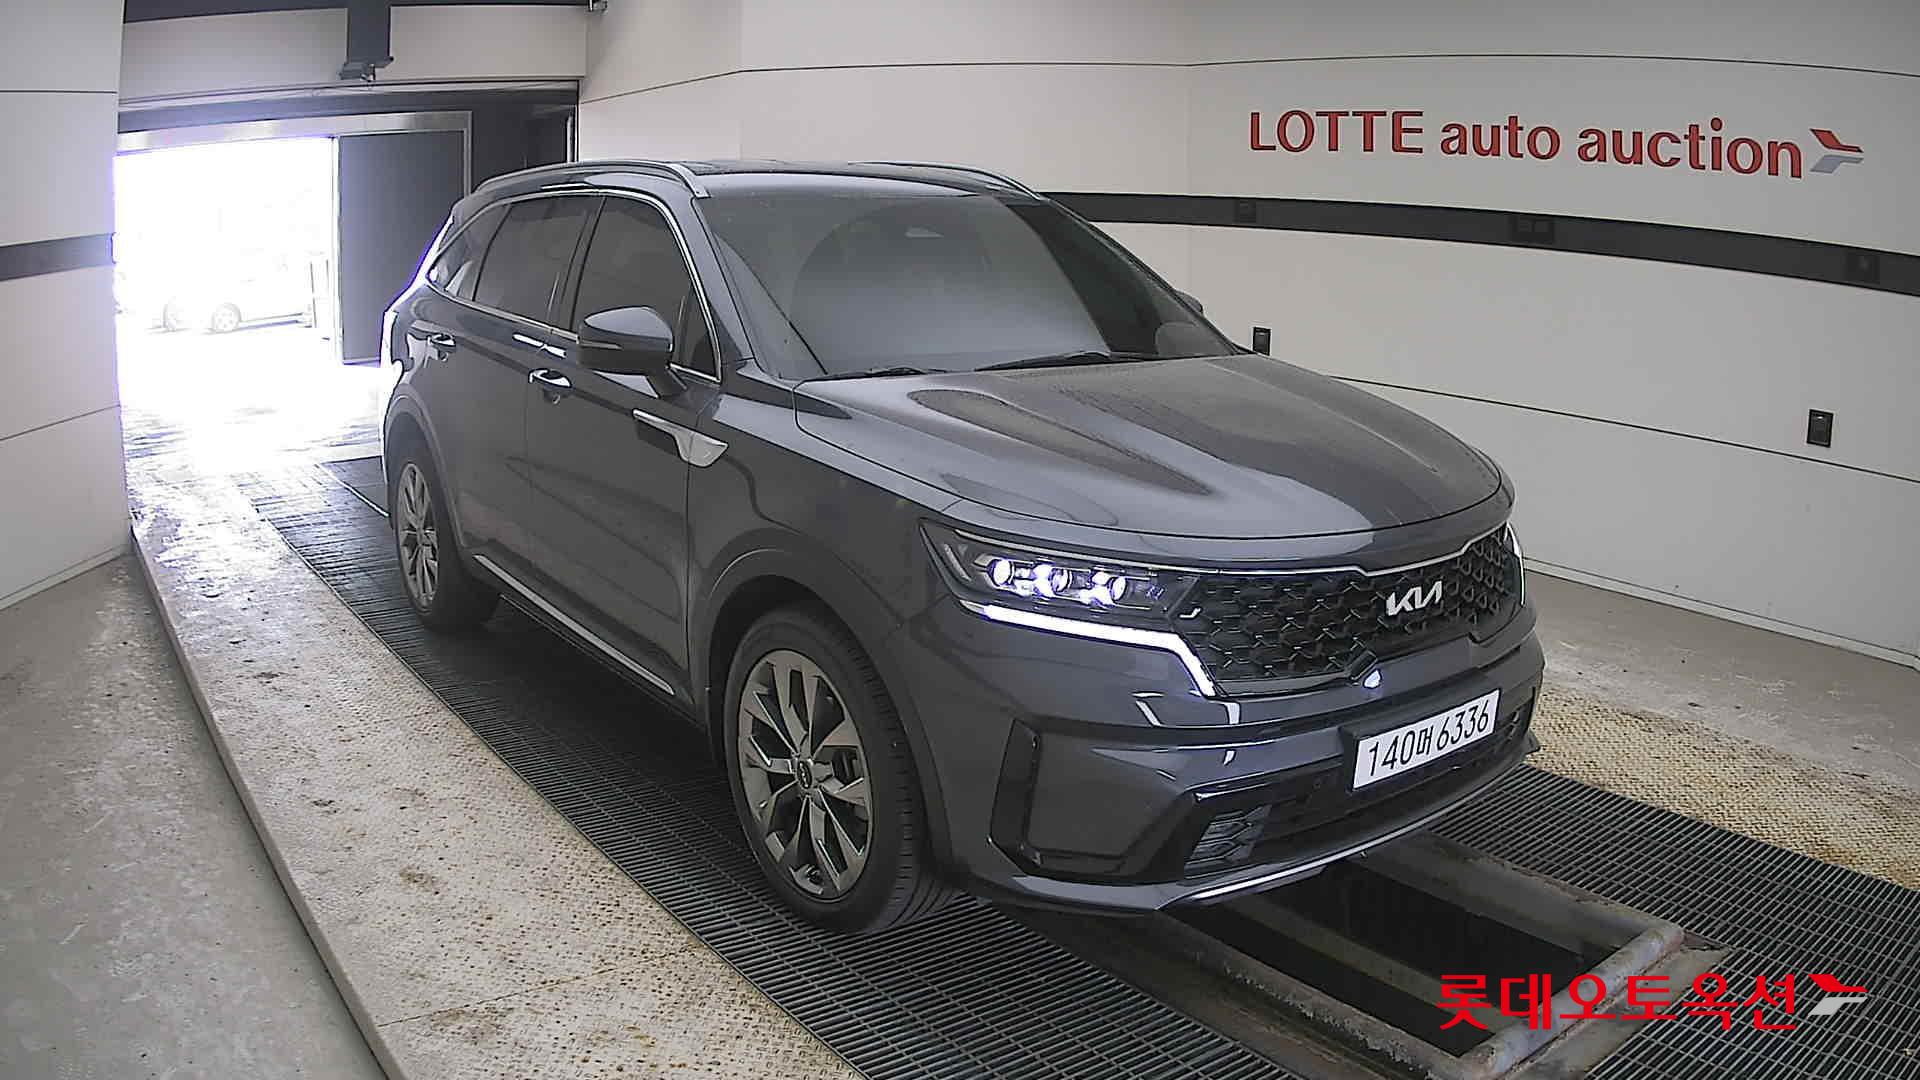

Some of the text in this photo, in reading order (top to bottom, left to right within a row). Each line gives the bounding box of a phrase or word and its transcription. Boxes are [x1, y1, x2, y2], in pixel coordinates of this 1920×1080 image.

[1249, 109, 1803, 179] LOTTE auto auction
[1386, 580, 1443, 616] KIA
